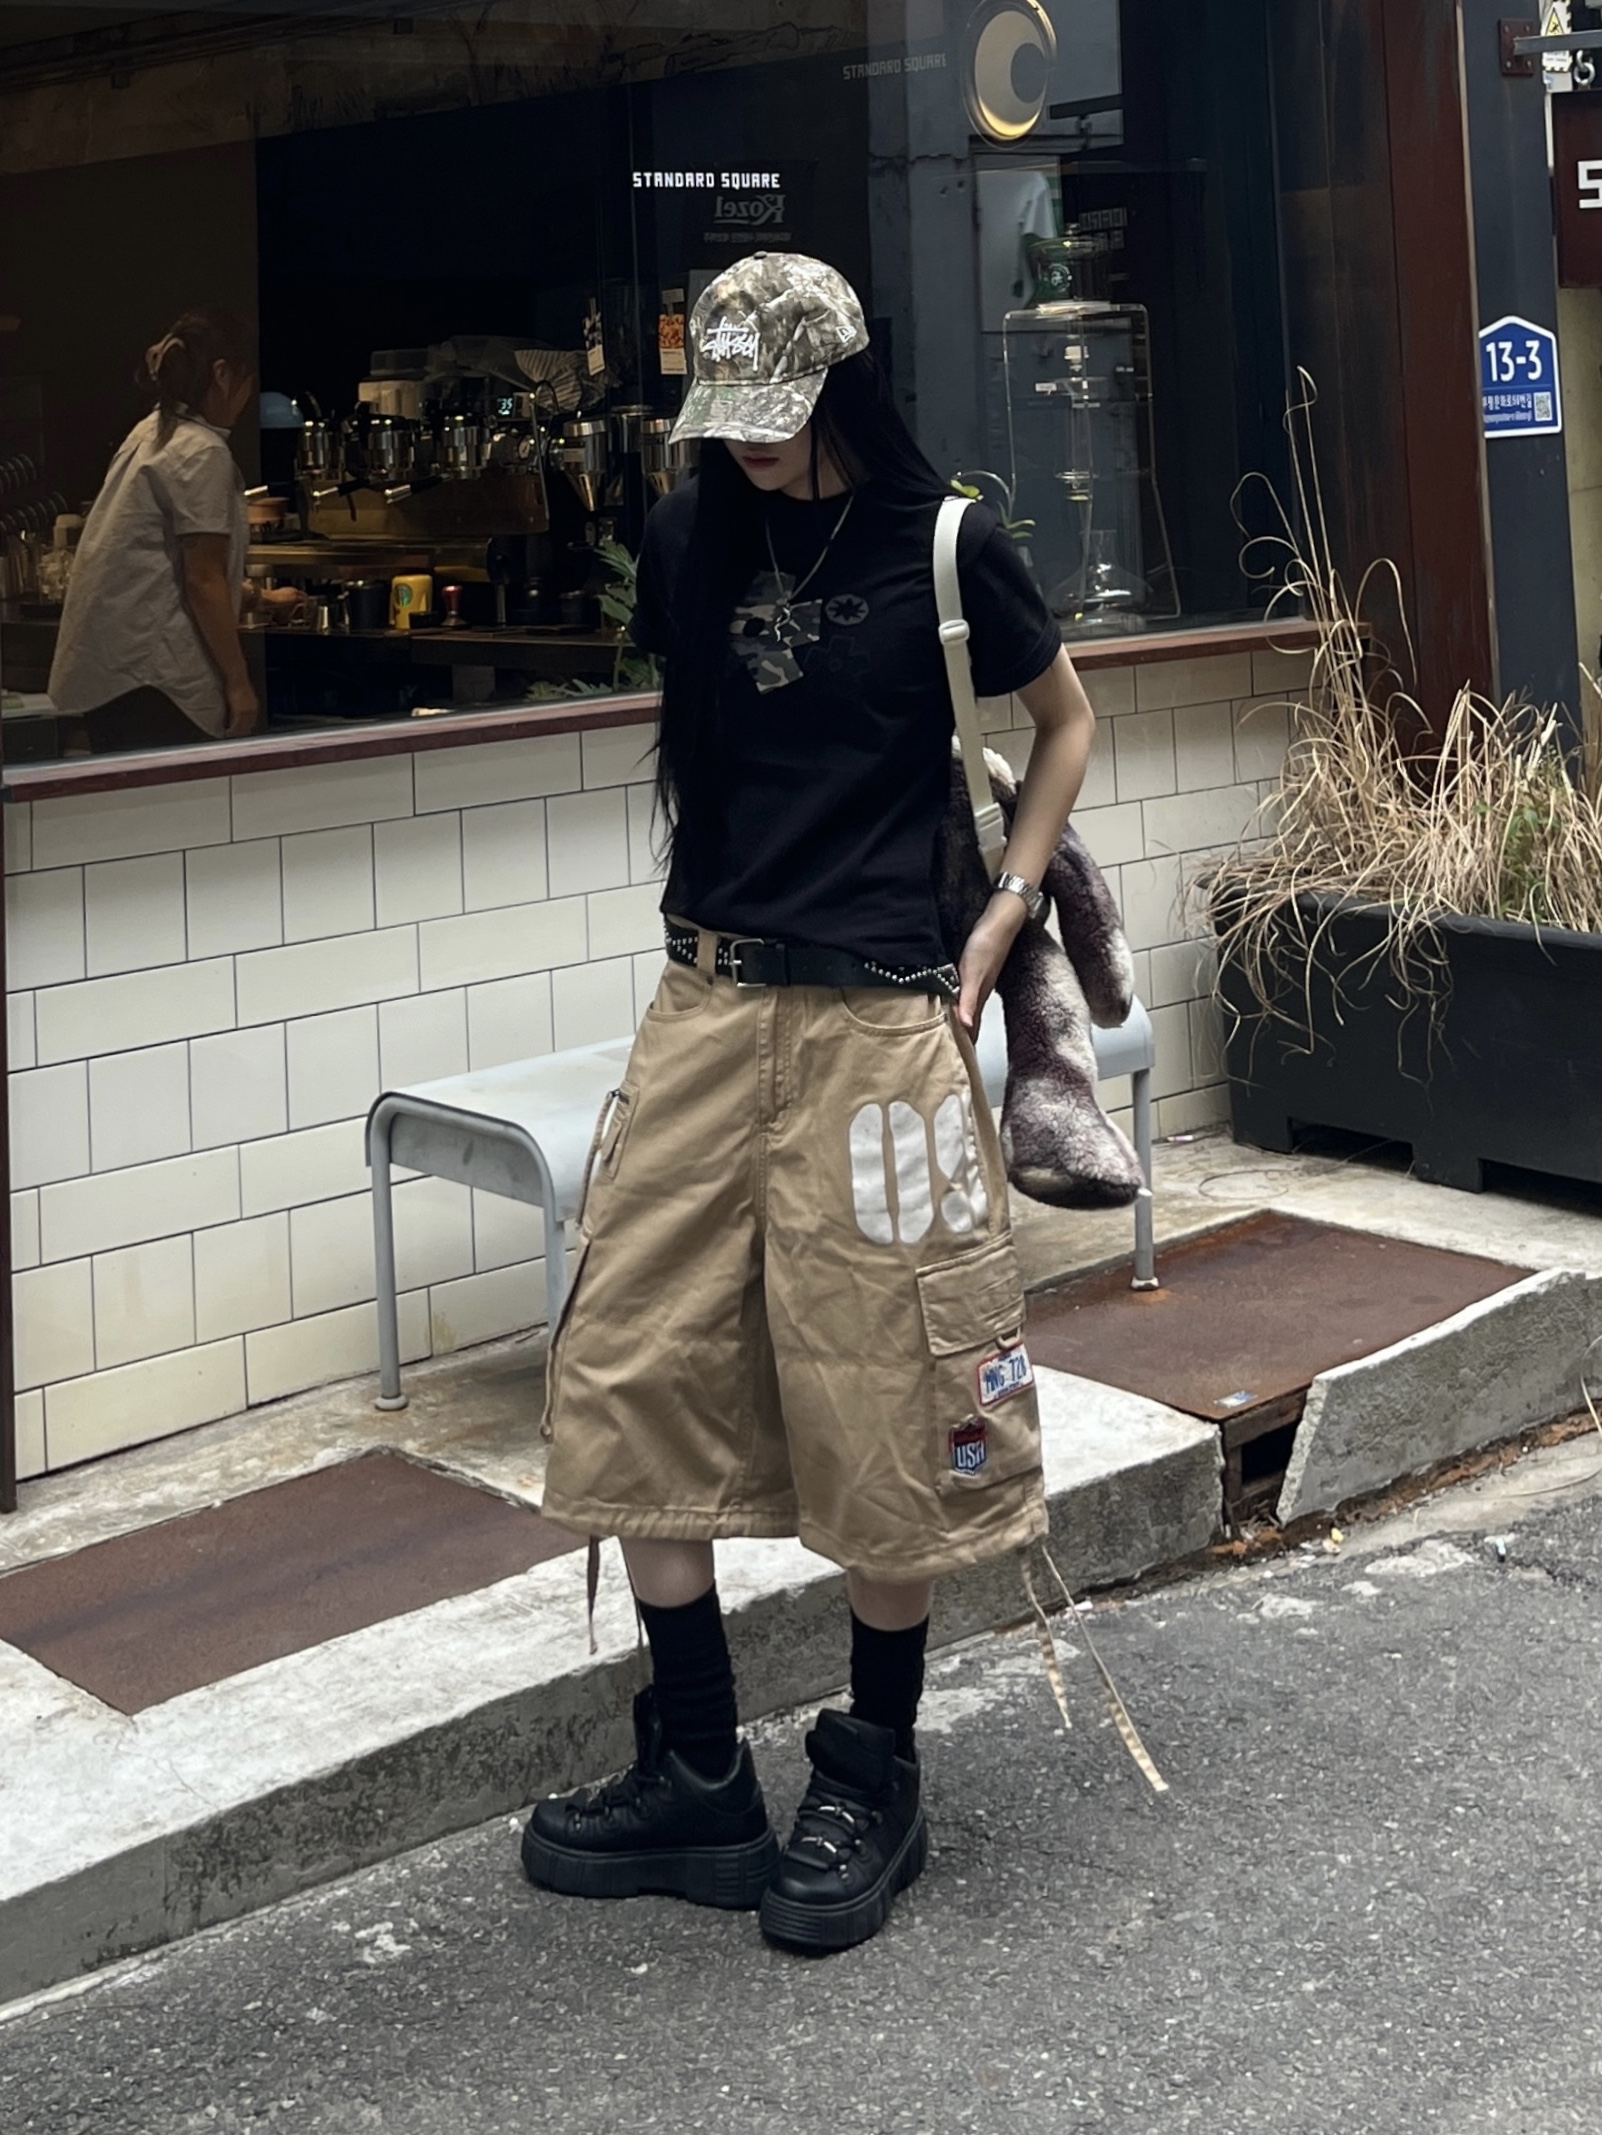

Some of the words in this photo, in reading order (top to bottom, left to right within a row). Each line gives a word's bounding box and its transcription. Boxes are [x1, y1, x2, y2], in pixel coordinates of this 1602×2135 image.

[842, 58, 902, 80] STANDARD
[903, 52, 947, 73] SQUARE
[631, 171, 715, 189] STANDARD
[719, 171, 781, 190] SQUARE
[1485, 340, 1542, 382] 13-3
[956, 1440, 985, 1469] USA
